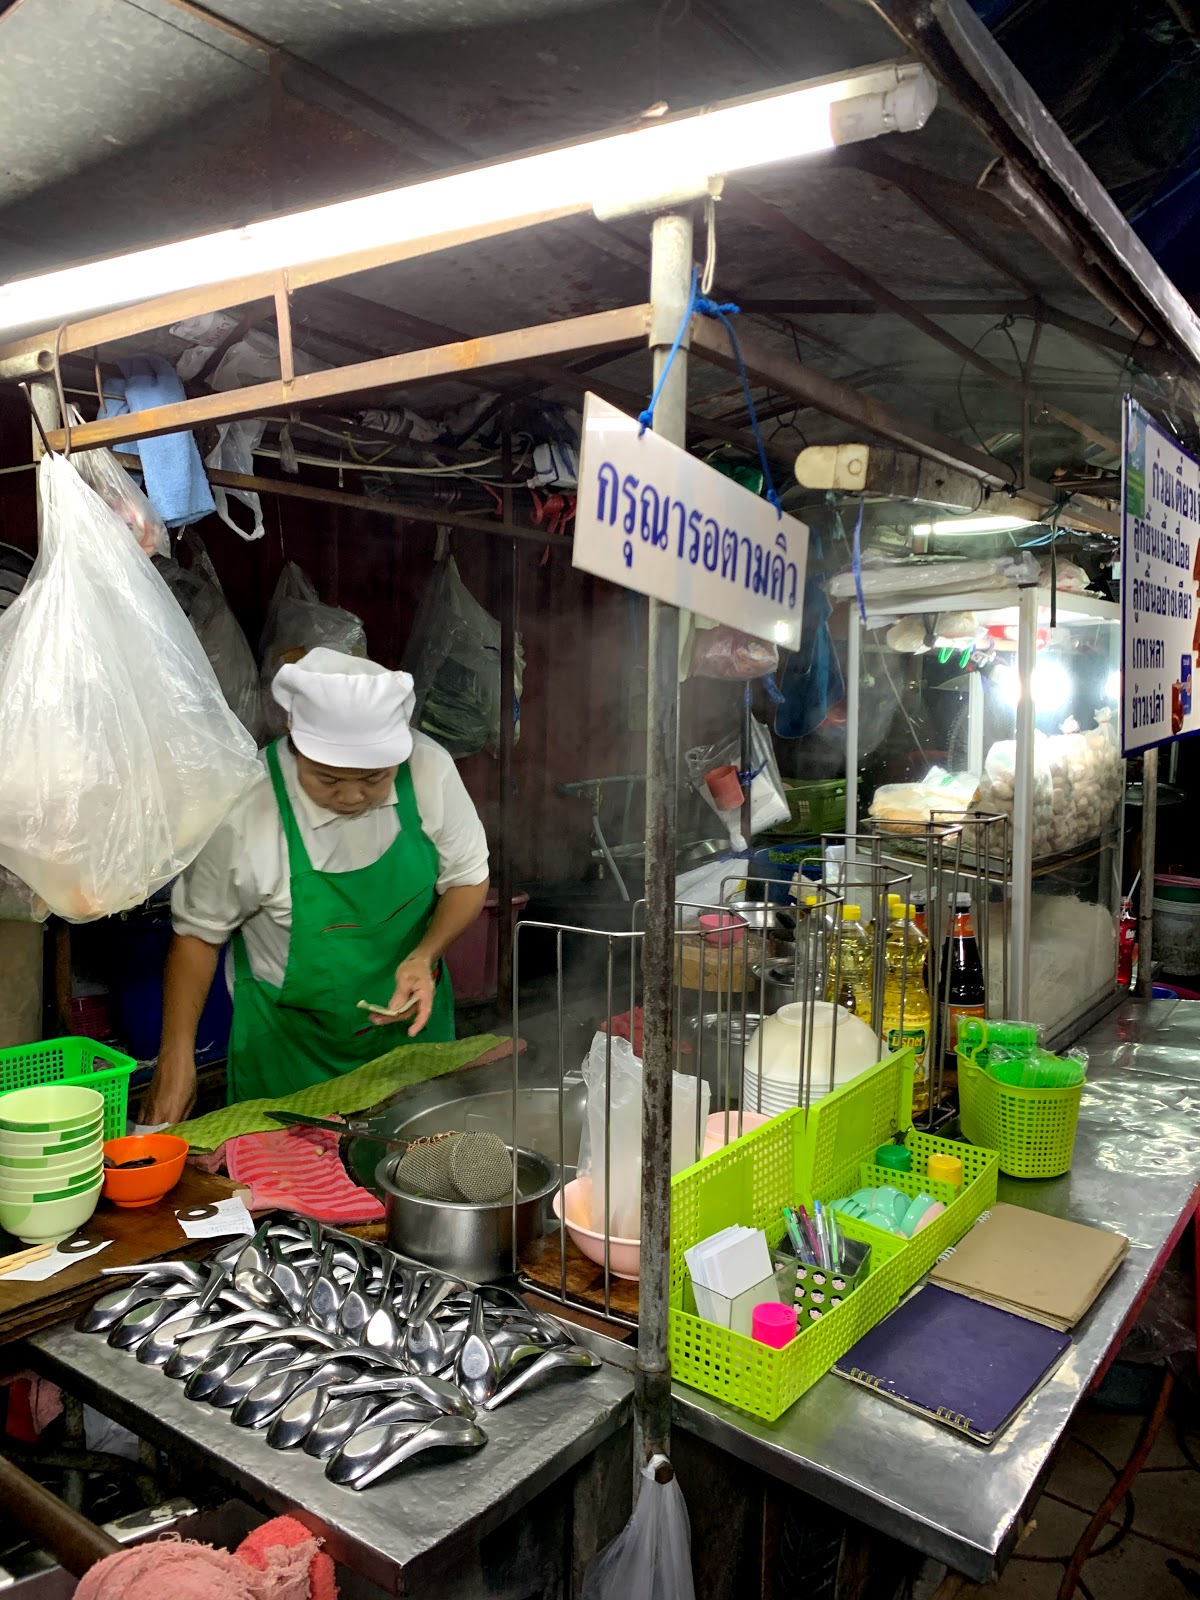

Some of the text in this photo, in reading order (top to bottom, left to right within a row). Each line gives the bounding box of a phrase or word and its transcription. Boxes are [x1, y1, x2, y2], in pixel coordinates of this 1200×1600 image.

[596, 462, 798, 611] กรุณารอตามคิว
[1132, 637, 1165, 669] เกาเหลา
[1132, 684, 1165, 728] ข้าวเปล่า
